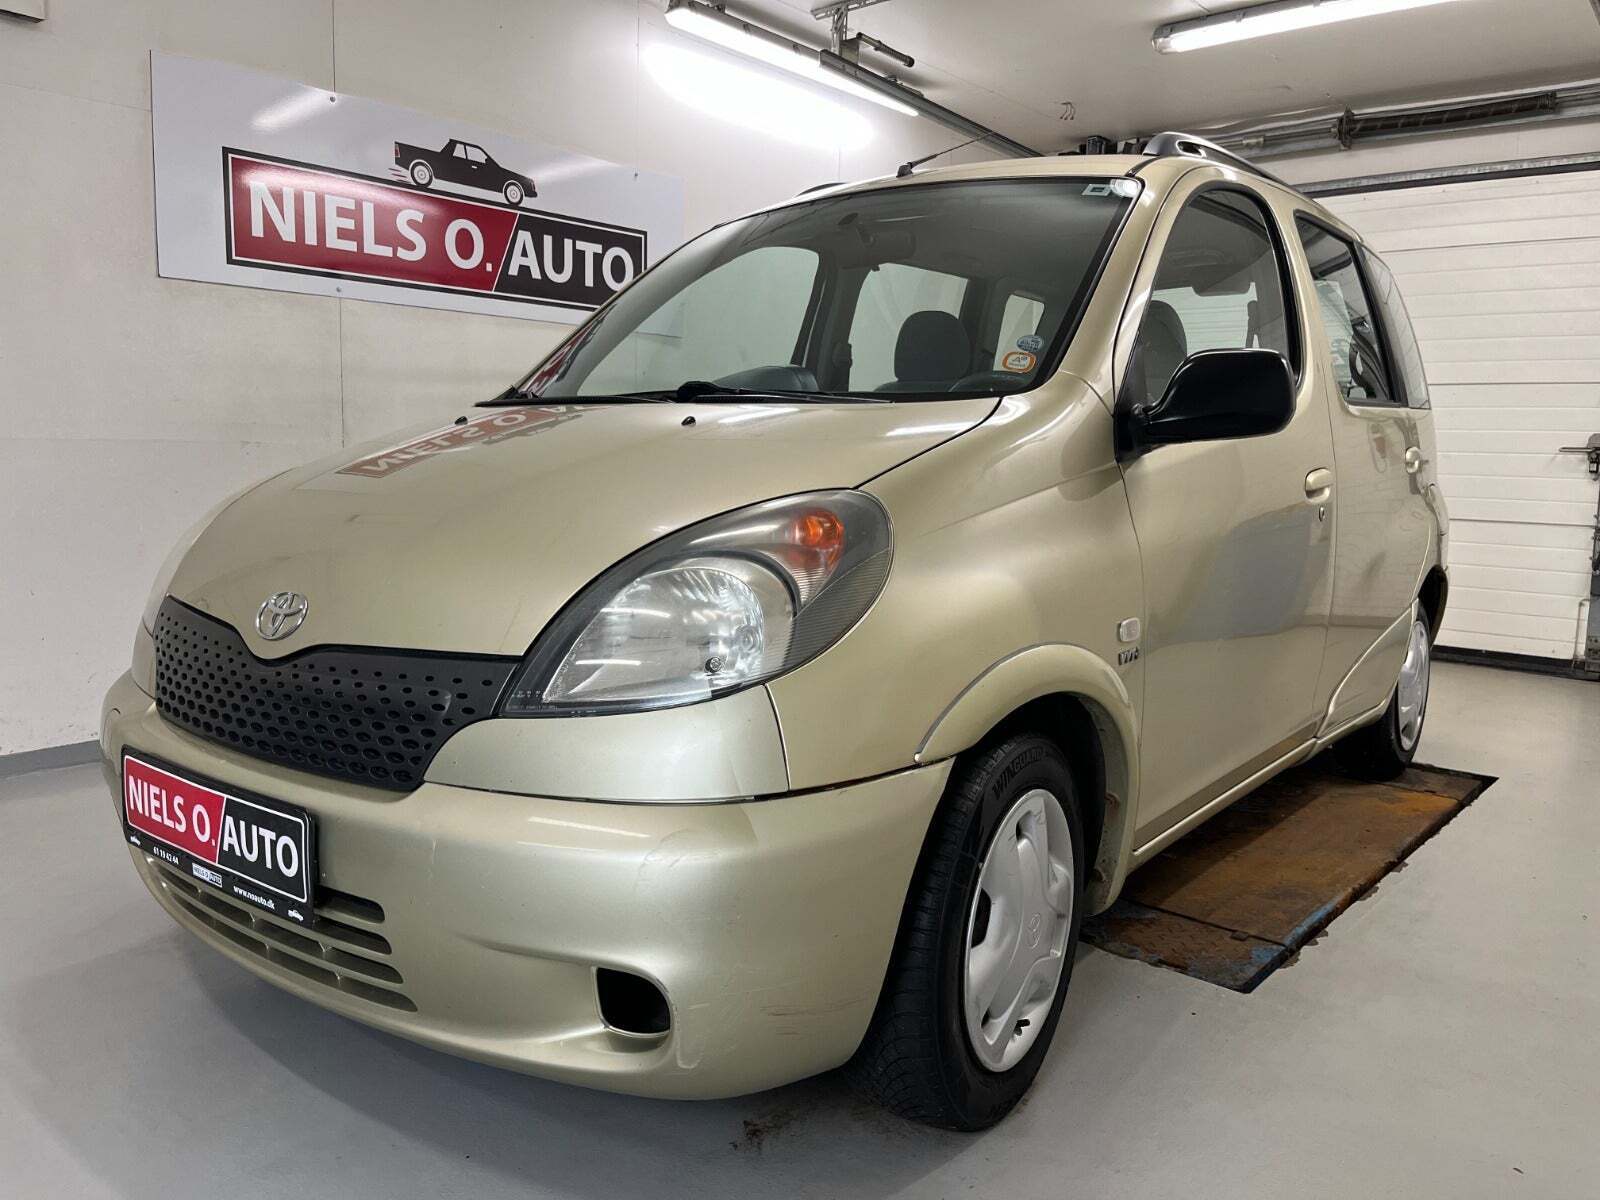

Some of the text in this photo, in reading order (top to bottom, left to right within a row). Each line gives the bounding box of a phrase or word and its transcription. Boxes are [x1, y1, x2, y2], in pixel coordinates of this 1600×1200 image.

[250, 181, 634, 292] NIELS O. AUTO
[128, 775, 299, 878] NIELS O. AUTO
